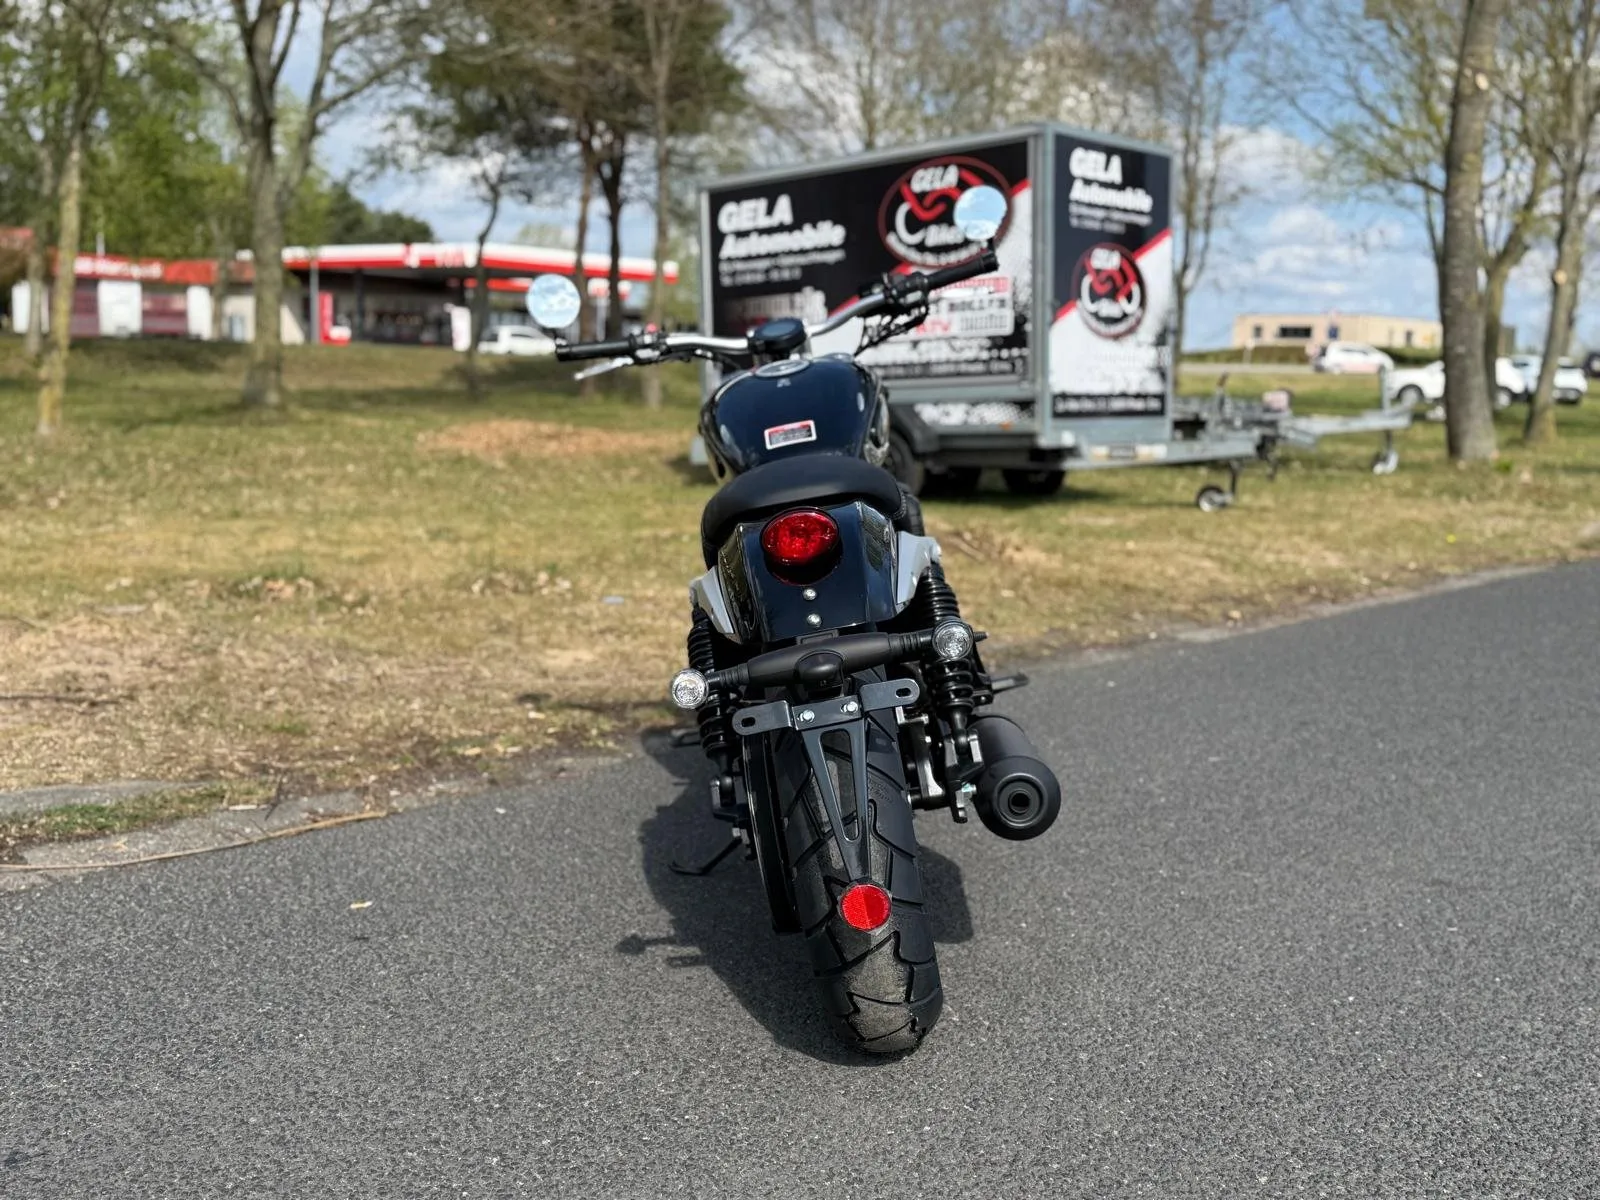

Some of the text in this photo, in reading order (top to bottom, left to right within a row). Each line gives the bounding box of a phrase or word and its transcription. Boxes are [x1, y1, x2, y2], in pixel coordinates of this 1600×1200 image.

[910, 164, 960, 194] GELA
[1069, 146, 1123, 185] GELA
[717, 193, 794, 234] GELA
[1069, 178, 1153, 214] Automobile
[719, 219, 846, 260] Automobile
